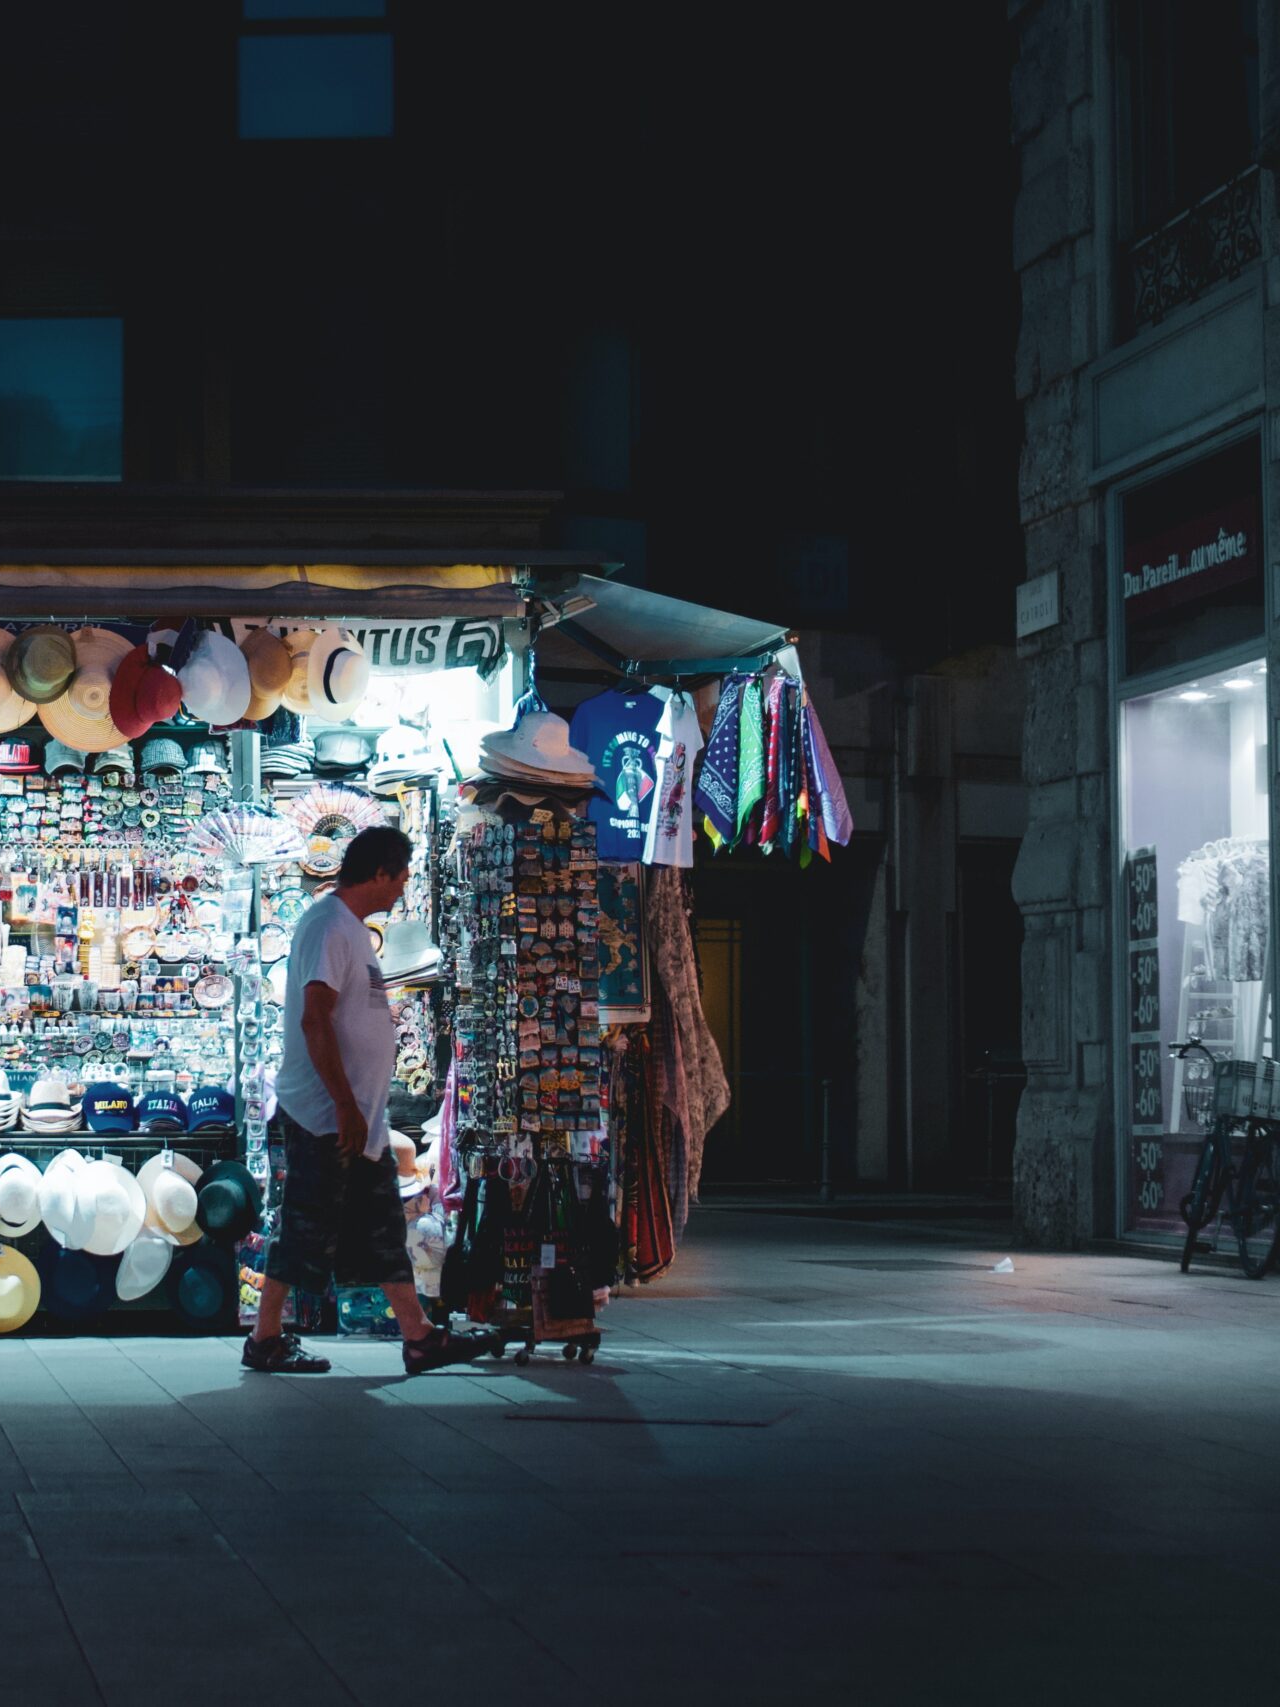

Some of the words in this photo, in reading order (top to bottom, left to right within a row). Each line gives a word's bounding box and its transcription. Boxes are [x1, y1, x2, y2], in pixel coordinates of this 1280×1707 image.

[637, 734, 651, 748] TO
[94, 1100, 128, 1110] MILANO
[147, 1099, 178, 1112] ITALIA
[191, 1097, 220, 1111] ITALIA
